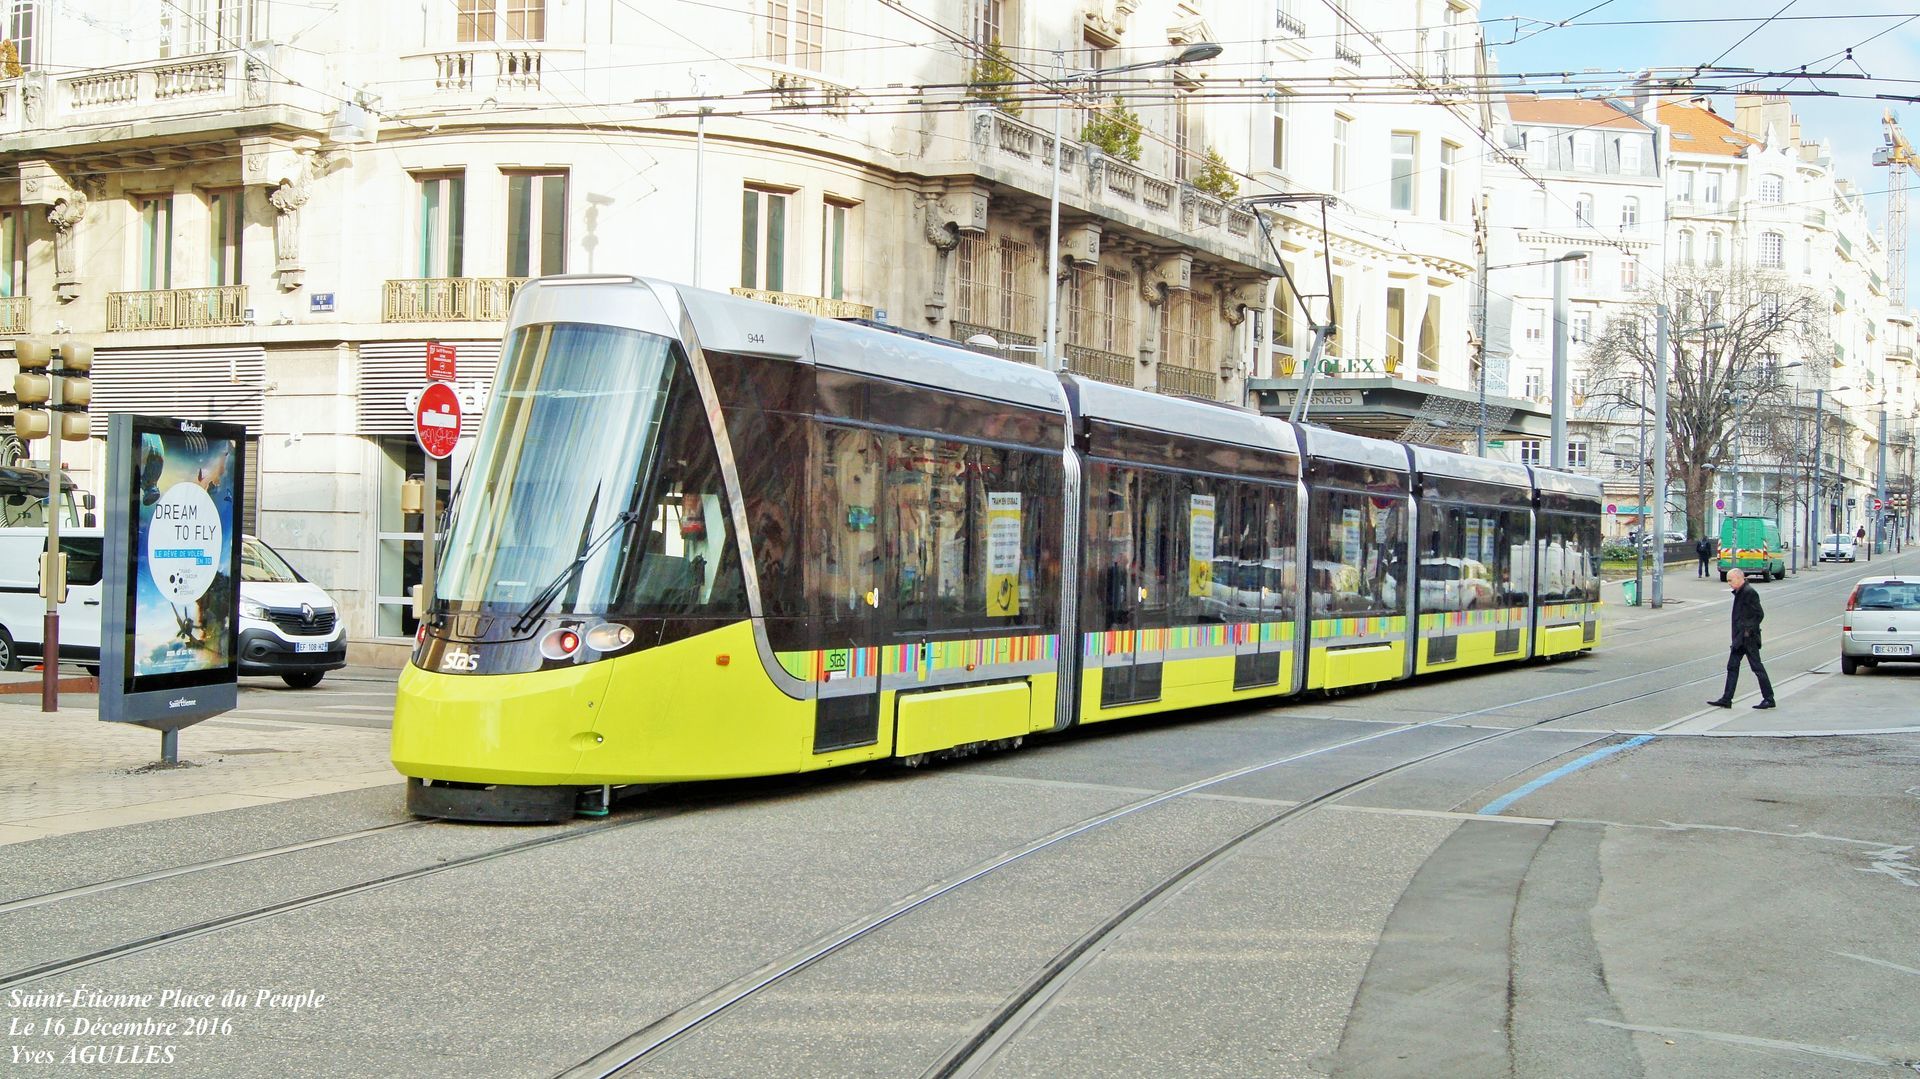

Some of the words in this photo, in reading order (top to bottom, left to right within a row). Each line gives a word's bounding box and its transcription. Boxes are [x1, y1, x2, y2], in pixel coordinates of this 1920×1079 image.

[747, 333, 765, 344] 944
[155, 504, 197, 520] DREAM
[174, 525, 189, 540] TO
[195, 525, 216, 540] FLY
[442, 648, 480, 670] stas
[830, 649, 847, 668] stas
